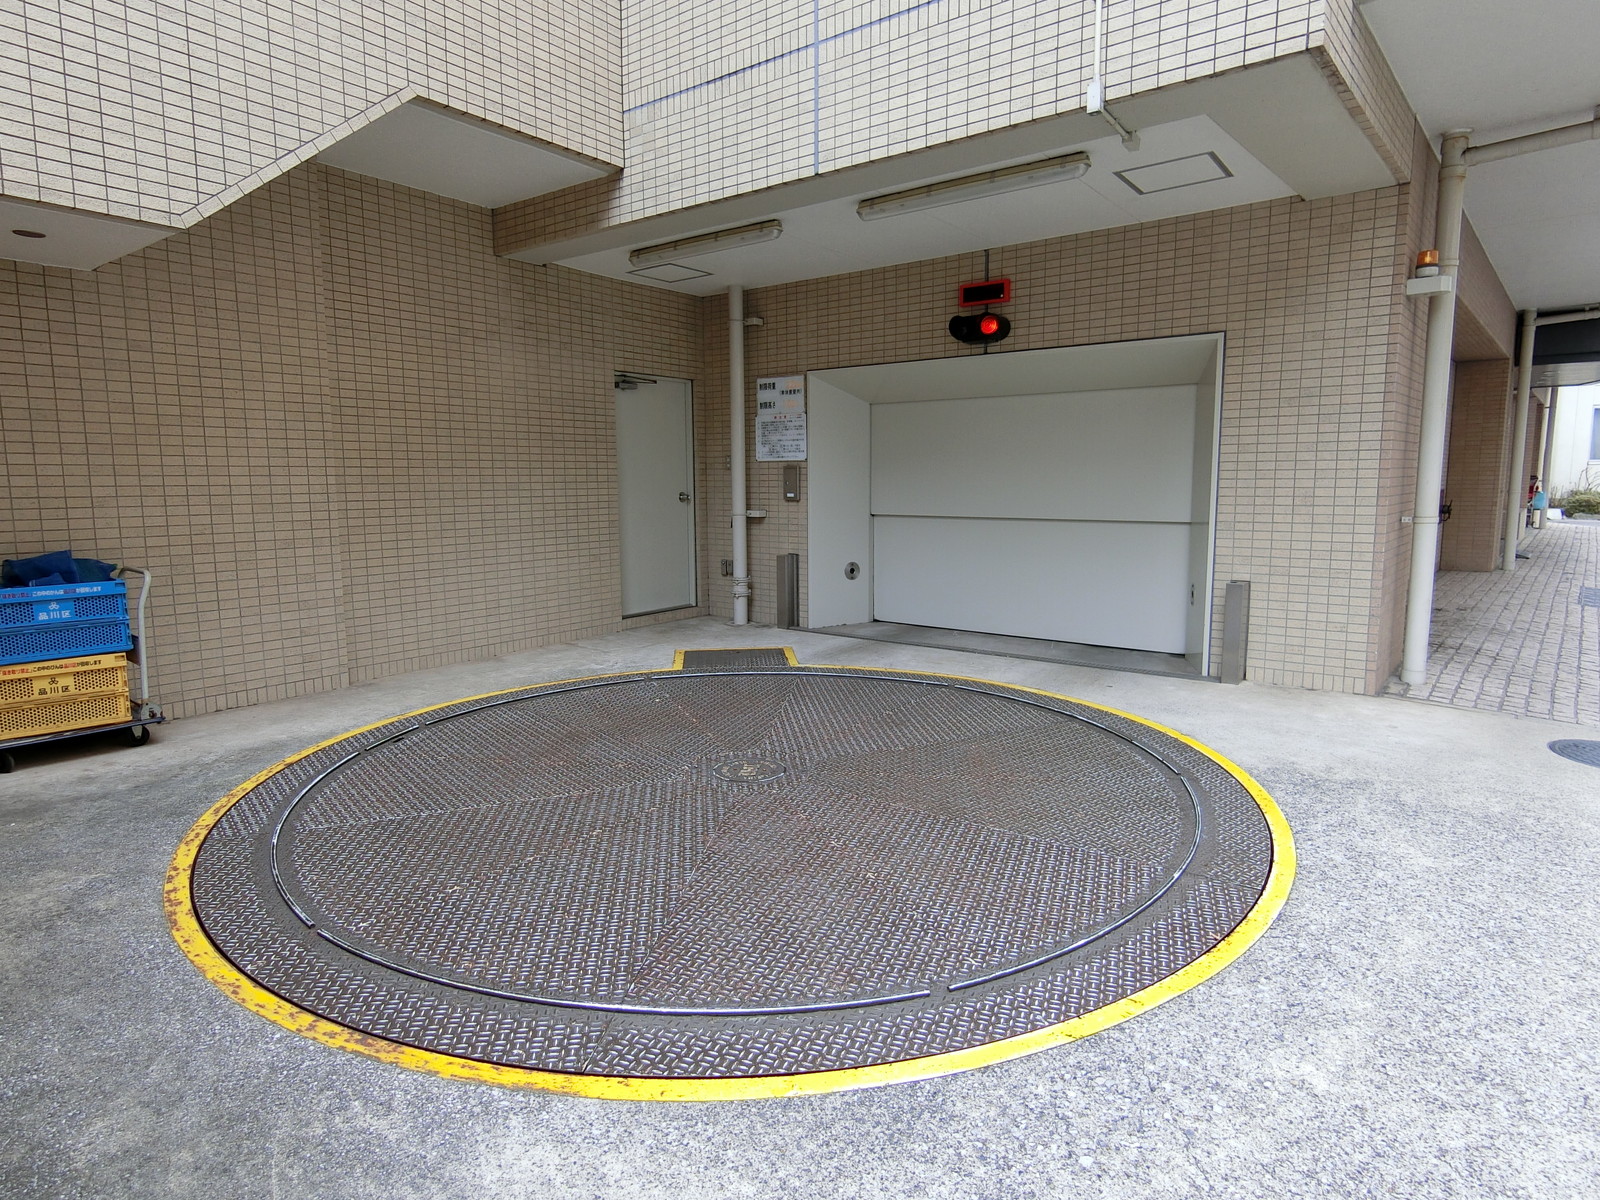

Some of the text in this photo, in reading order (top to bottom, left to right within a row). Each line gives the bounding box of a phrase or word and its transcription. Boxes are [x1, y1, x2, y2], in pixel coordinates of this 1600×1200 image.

[39, 610, 71, 620] 品川区
[38, 685, 70, 696] 品川区
